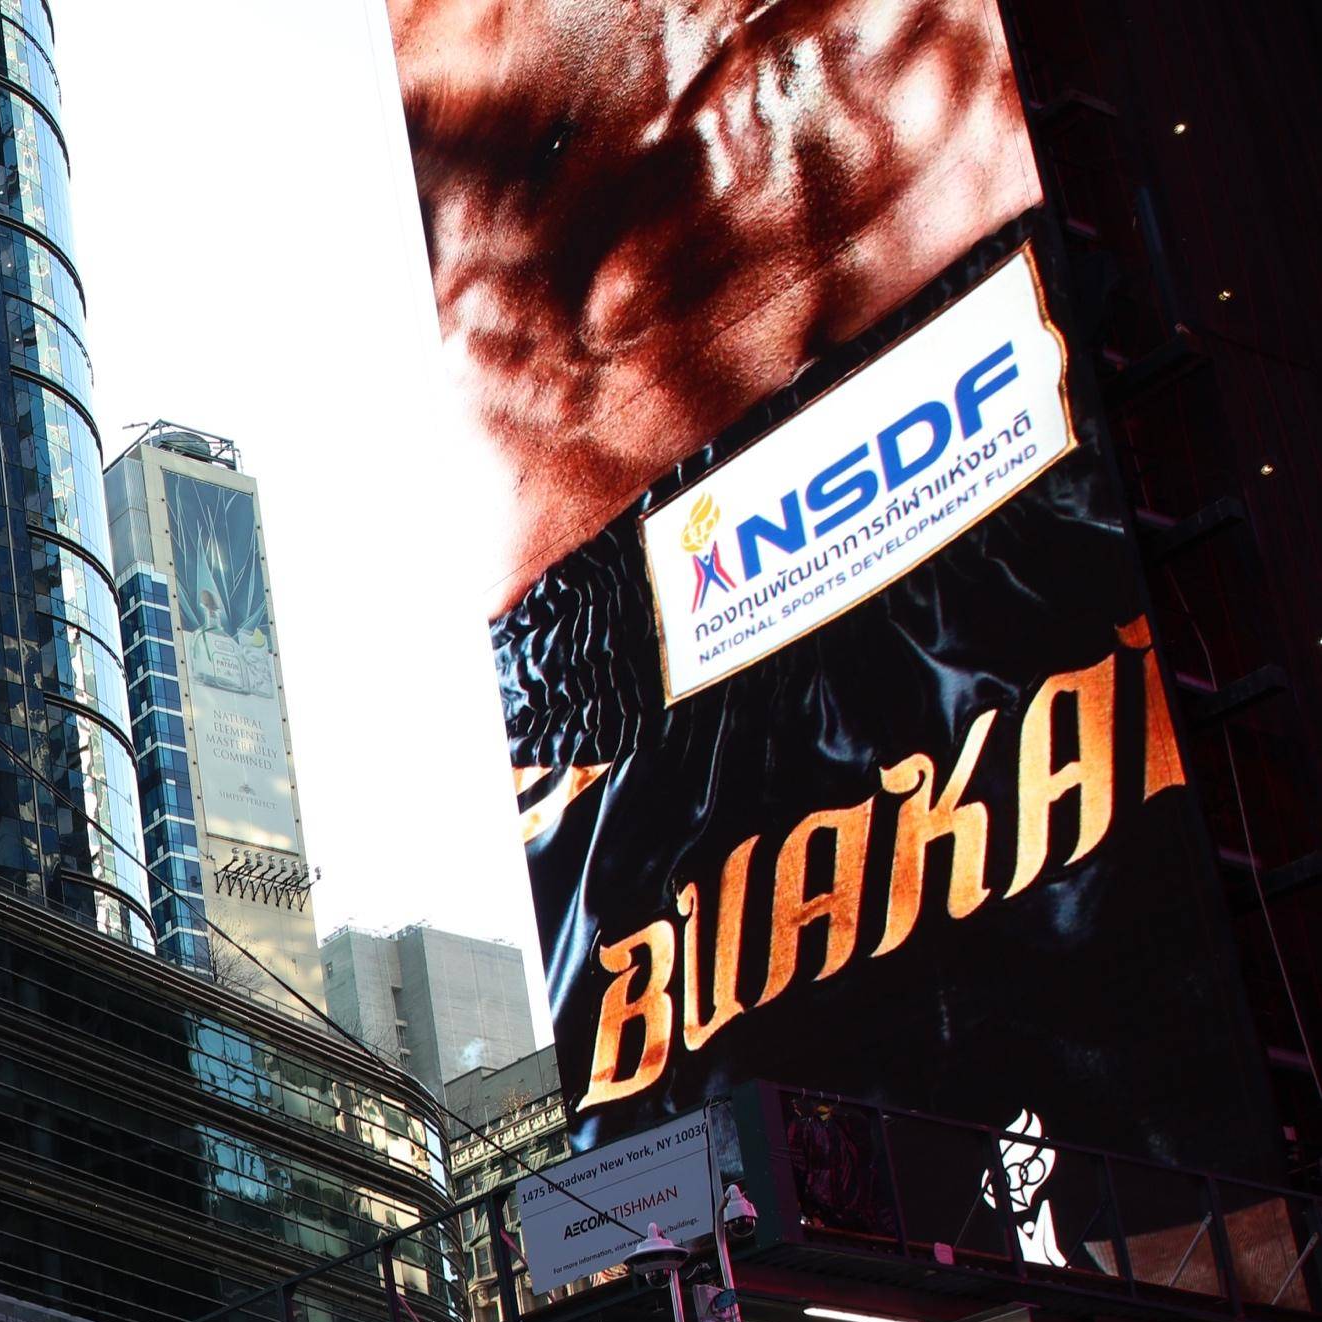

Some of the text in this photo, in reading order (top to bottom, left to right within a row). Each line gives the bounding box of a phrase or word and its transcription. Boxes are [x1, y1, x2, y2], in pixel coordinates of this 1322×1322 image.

[736, 340, 1019, 581] NSDF
[698, 443, 1038, 665] NATIONAL SPORTS DEVELOPMENT FUND
[213, 709, 263, 731] NATURAL
[214, 721, 267, 743] ELEMENTS
[206, 733, 278, 759] MASTERFULLY
[522, 1185, 546, 1205] 1475
[547, 1167, 598, 1194] Broadway
[599, 1156, 624, 1173] New
[626, 1146, 654, 1163] York,
[656, 1137, 672, 1153] NY
[564, 1210, 610, 1241] AECOM
[610, 1185, 679, 1220] TISHMAN
[563, 1260, 578, 1271] more
